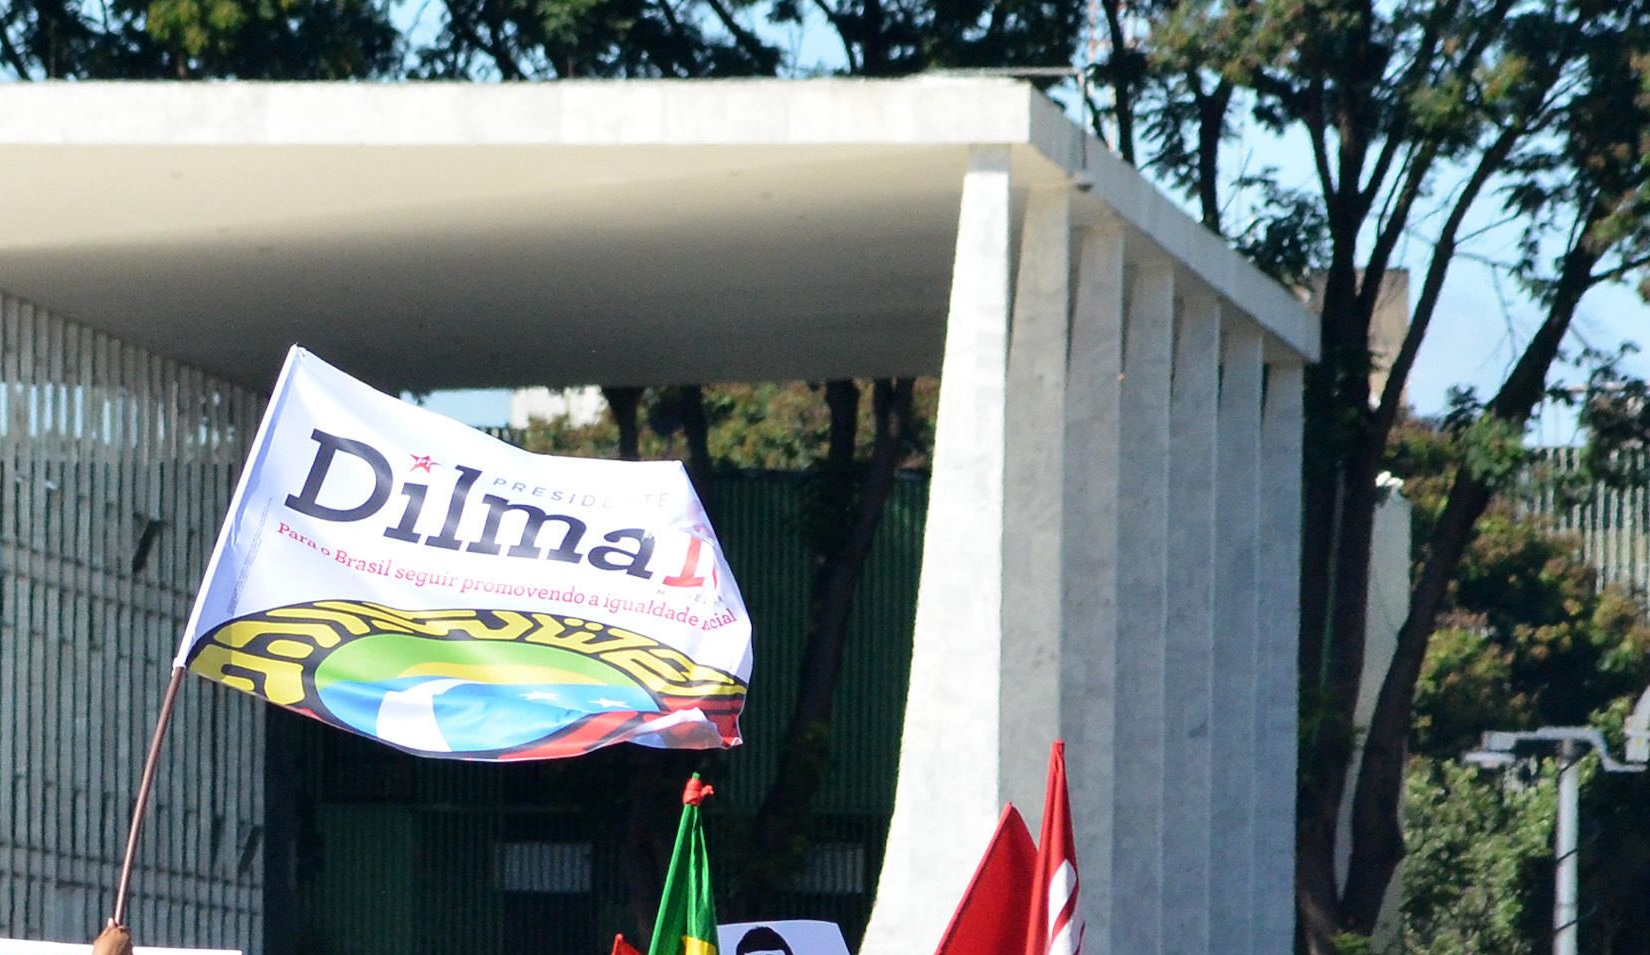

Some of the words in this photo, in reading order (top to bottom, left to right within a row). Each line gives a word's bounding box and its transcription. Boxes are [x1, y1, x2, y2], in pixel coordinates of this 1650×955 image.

[284, 428, 656, 580] Dilma
[493, 478, 669, 509] PRESIDTE
[277, 521, 317, 550] Para
[320, 547, 331, 557] o
[334, 549, 392, 577] Brasil
[394, 567, 459, 588] seguir
[459, 577, 586, 606] promovendo
[588, 594, 600, 608] a
[603, 596, 700, 628] igualdade
